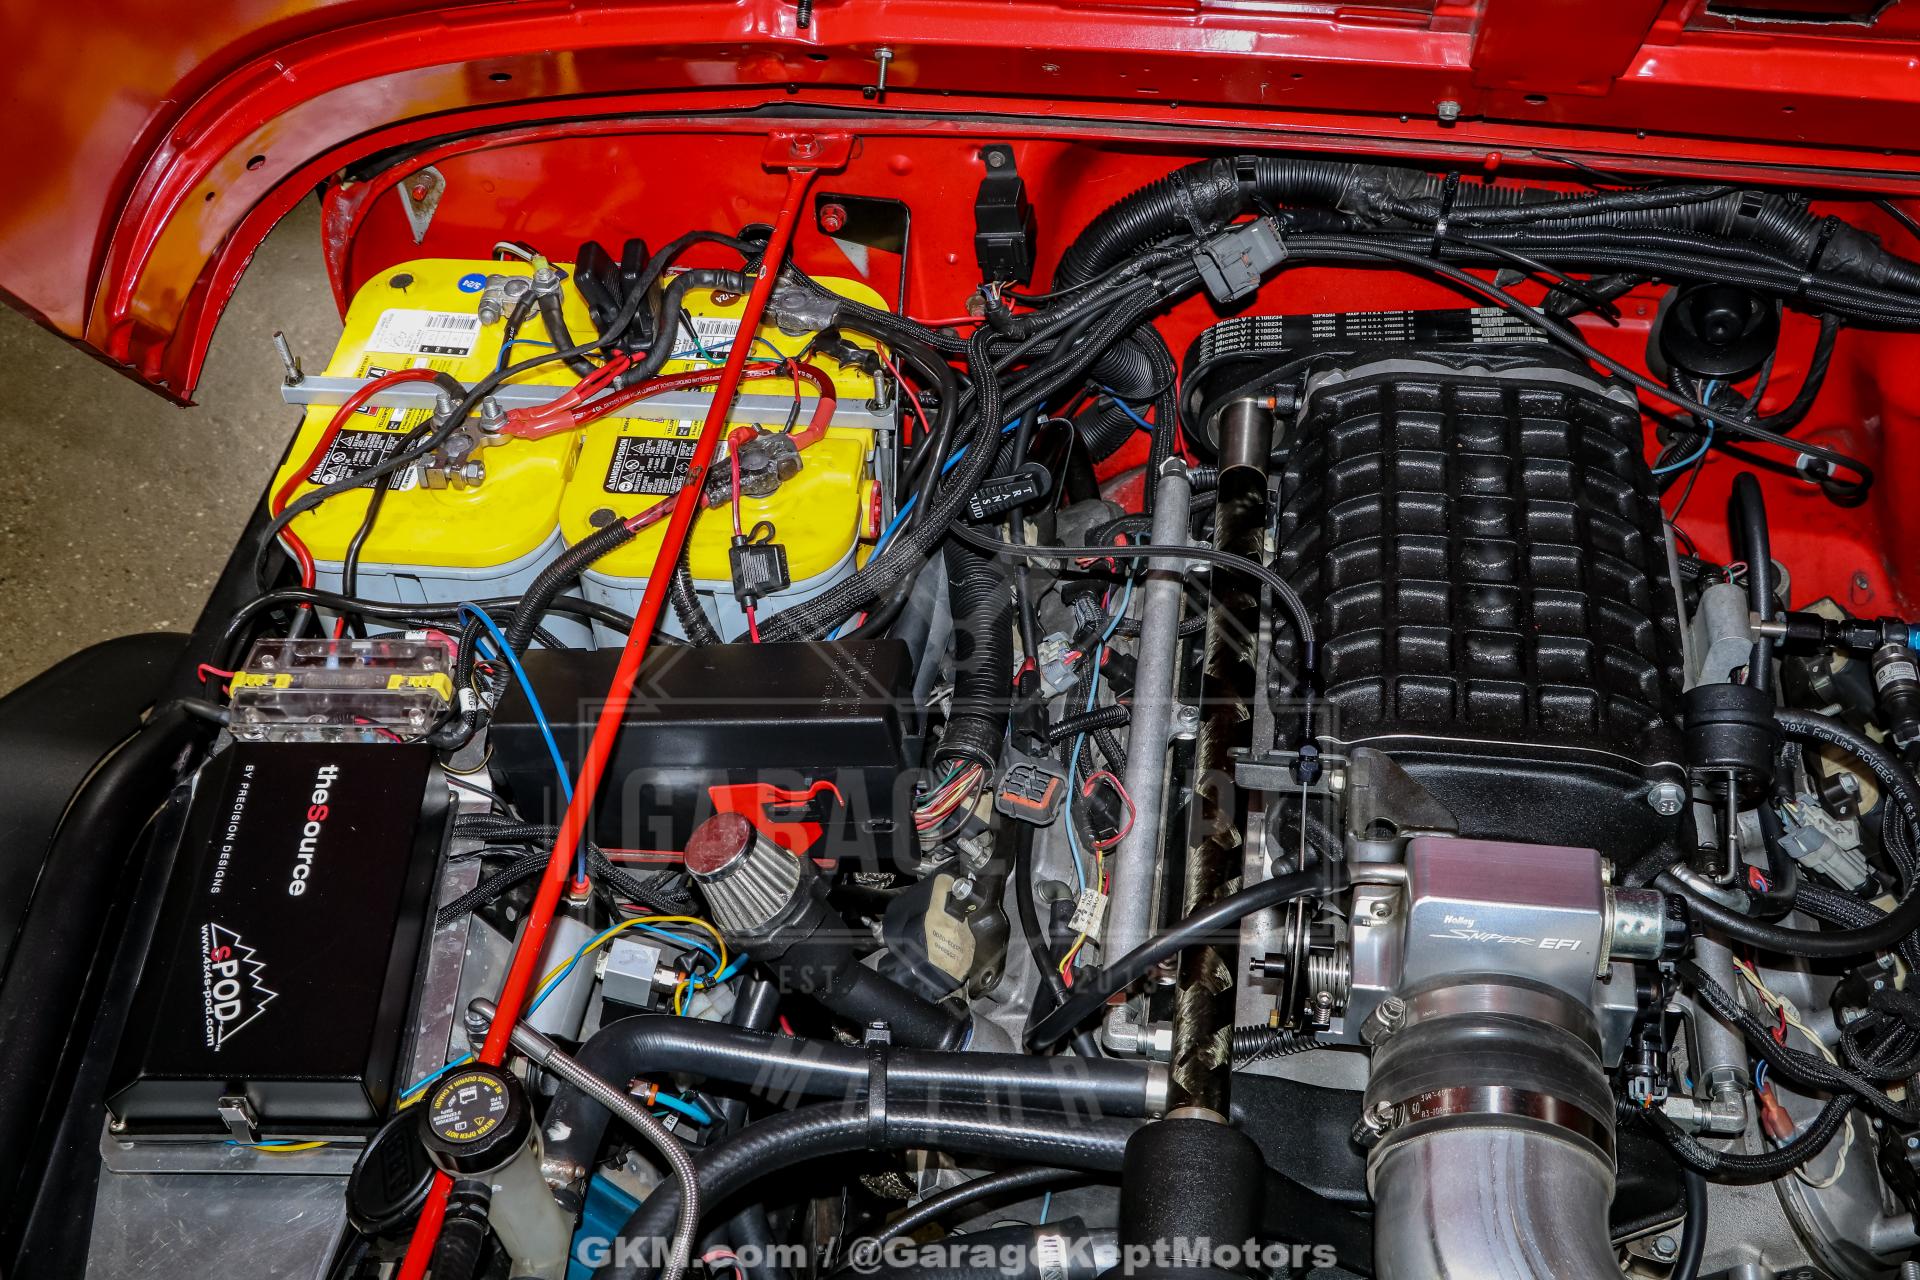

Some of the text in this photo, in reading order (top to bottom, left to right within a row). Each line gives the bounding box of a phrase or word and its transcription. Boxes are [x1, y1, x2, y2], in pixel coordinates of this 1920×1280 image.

[462, 279, 482, 290] 5/24
[609, 438, 630, 484] DANGER/POISON
[1813, 727, 1834, 741] Fuel
[1834, 735, 1853, 752] Line
[1856, 748, 1894, 784] PCV/EEC
[210, 765, 255, 894] BY PRECISION DESIGNS
[288, 764, 340, 897] theSource
[1443, 914, 1475, 929] Holley
[1428, 928, 1583, 951] SNIPER EFI
[201, 923, 216, 1047] www.4x4s-pod.com
[453, 1075, 477, 1087] OUVRIR
[477, 1075, 498, 1088] JAMAIS
[434, 1088, 450, 1109] CHAUD!
[444, 1118, 497, 1140] NEVER OPEN HOT!
